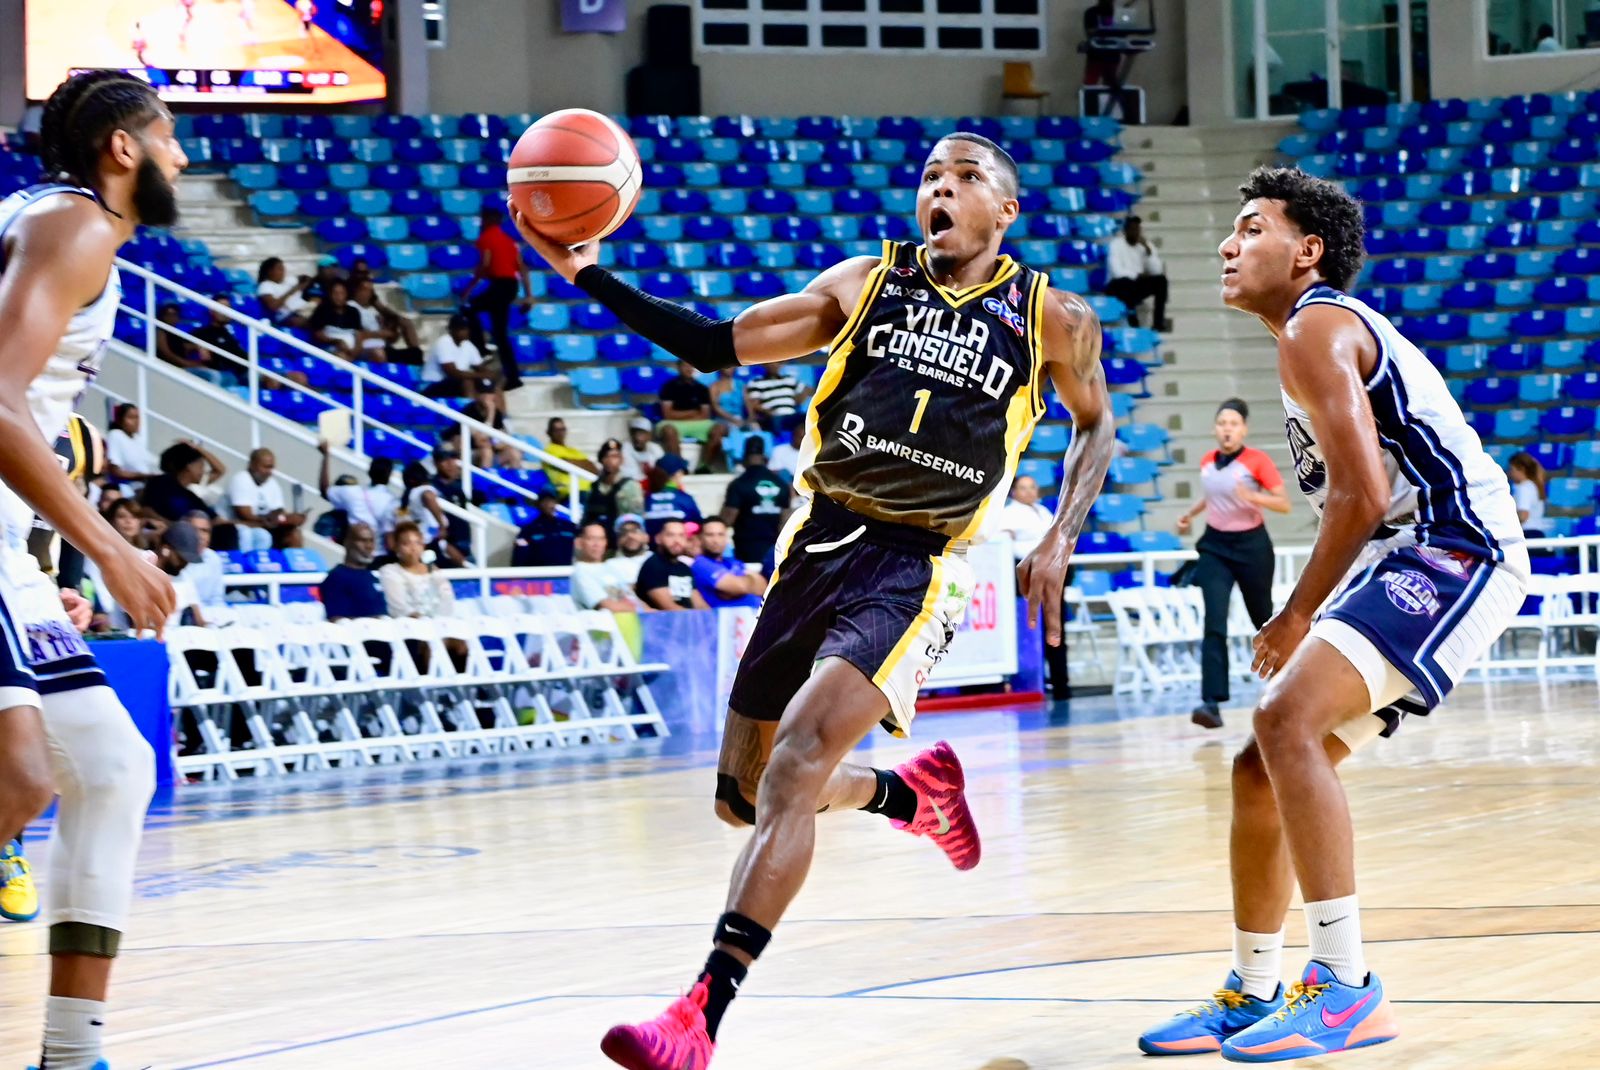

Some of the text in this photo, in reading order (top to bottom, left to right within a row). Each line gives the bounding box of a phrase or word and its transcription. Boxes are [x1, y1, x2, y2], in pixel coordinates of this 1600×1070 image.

[904, 304, 990, 353] VILLA
[866, 323, 1014, 400] CONSUELO
[897, 357, 966, 388] EL BARIAS
[908, 388, 932, 434] 1
[866, 435, 985, 485] BANRESERVAS
